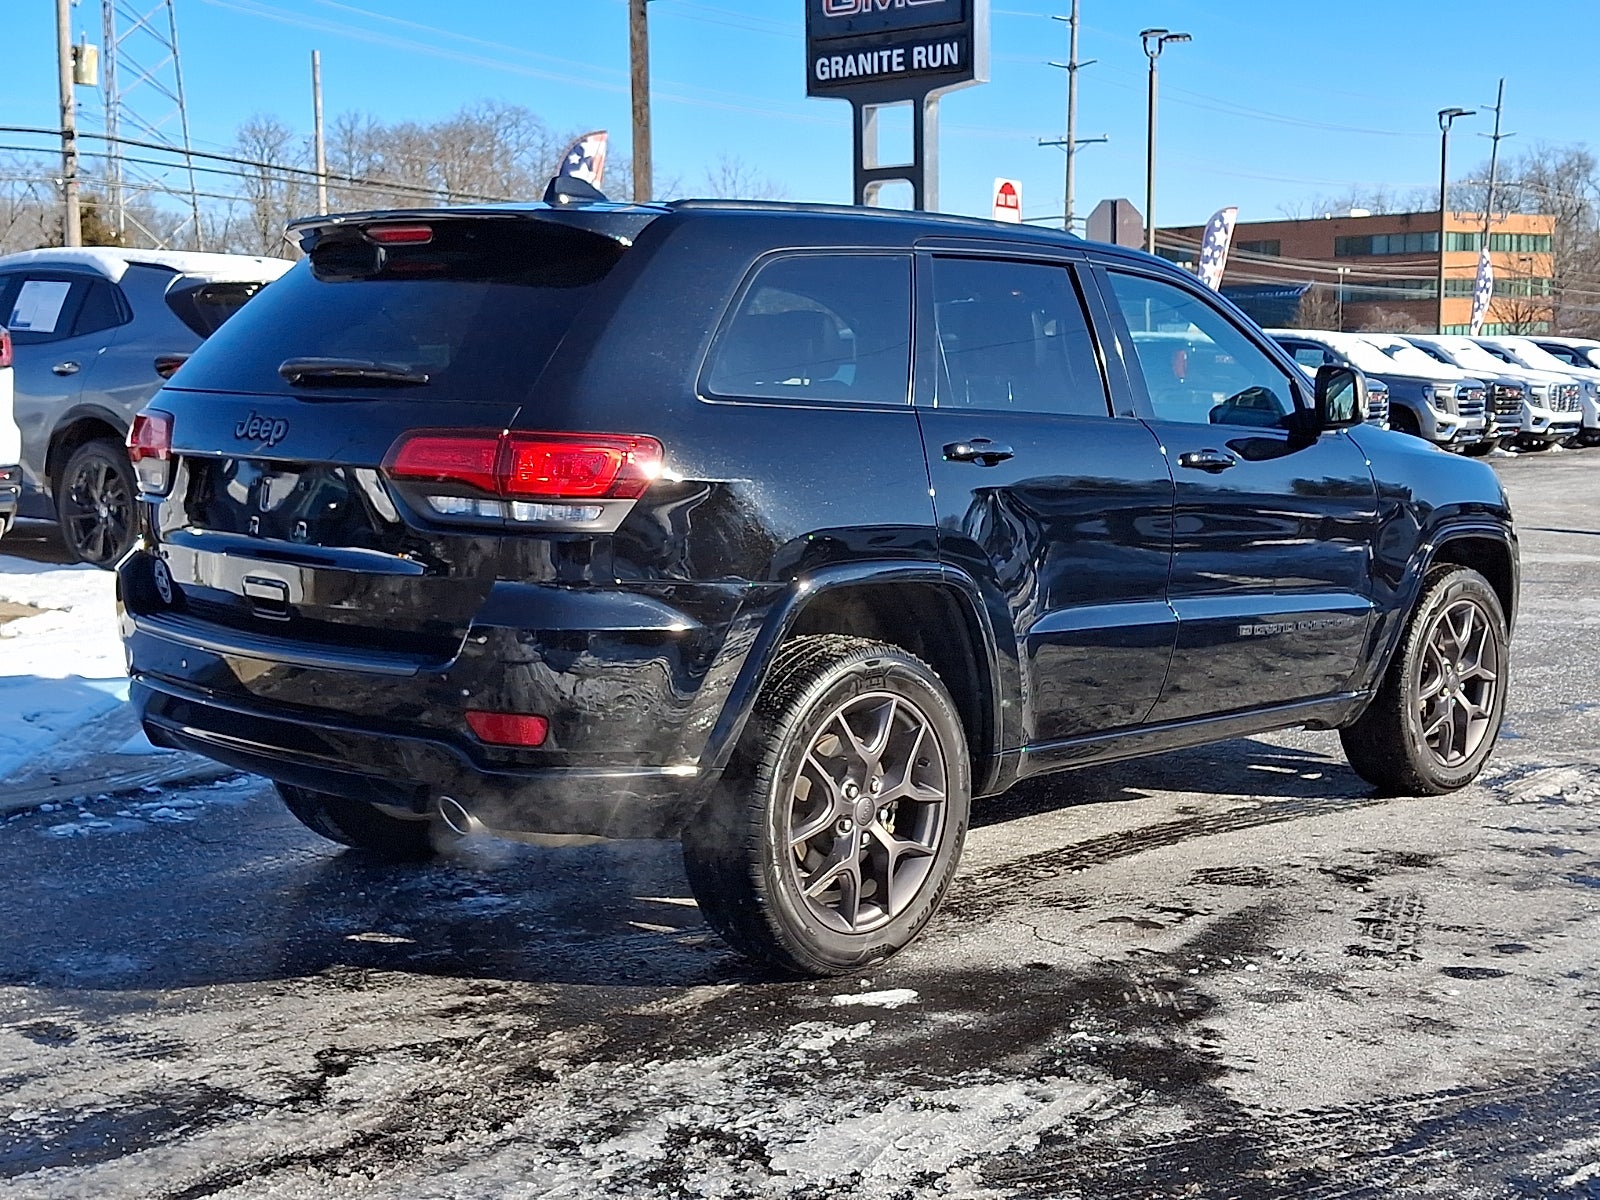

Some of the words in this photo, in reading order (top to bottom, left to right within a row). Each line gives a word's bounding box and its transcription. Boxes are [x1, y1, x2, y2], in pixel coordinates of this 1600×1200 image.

[815, 49, 905, 81] GRANITE
[912, 42, 959, 70] RUN
[235, 410, 289, 447] Jeep
